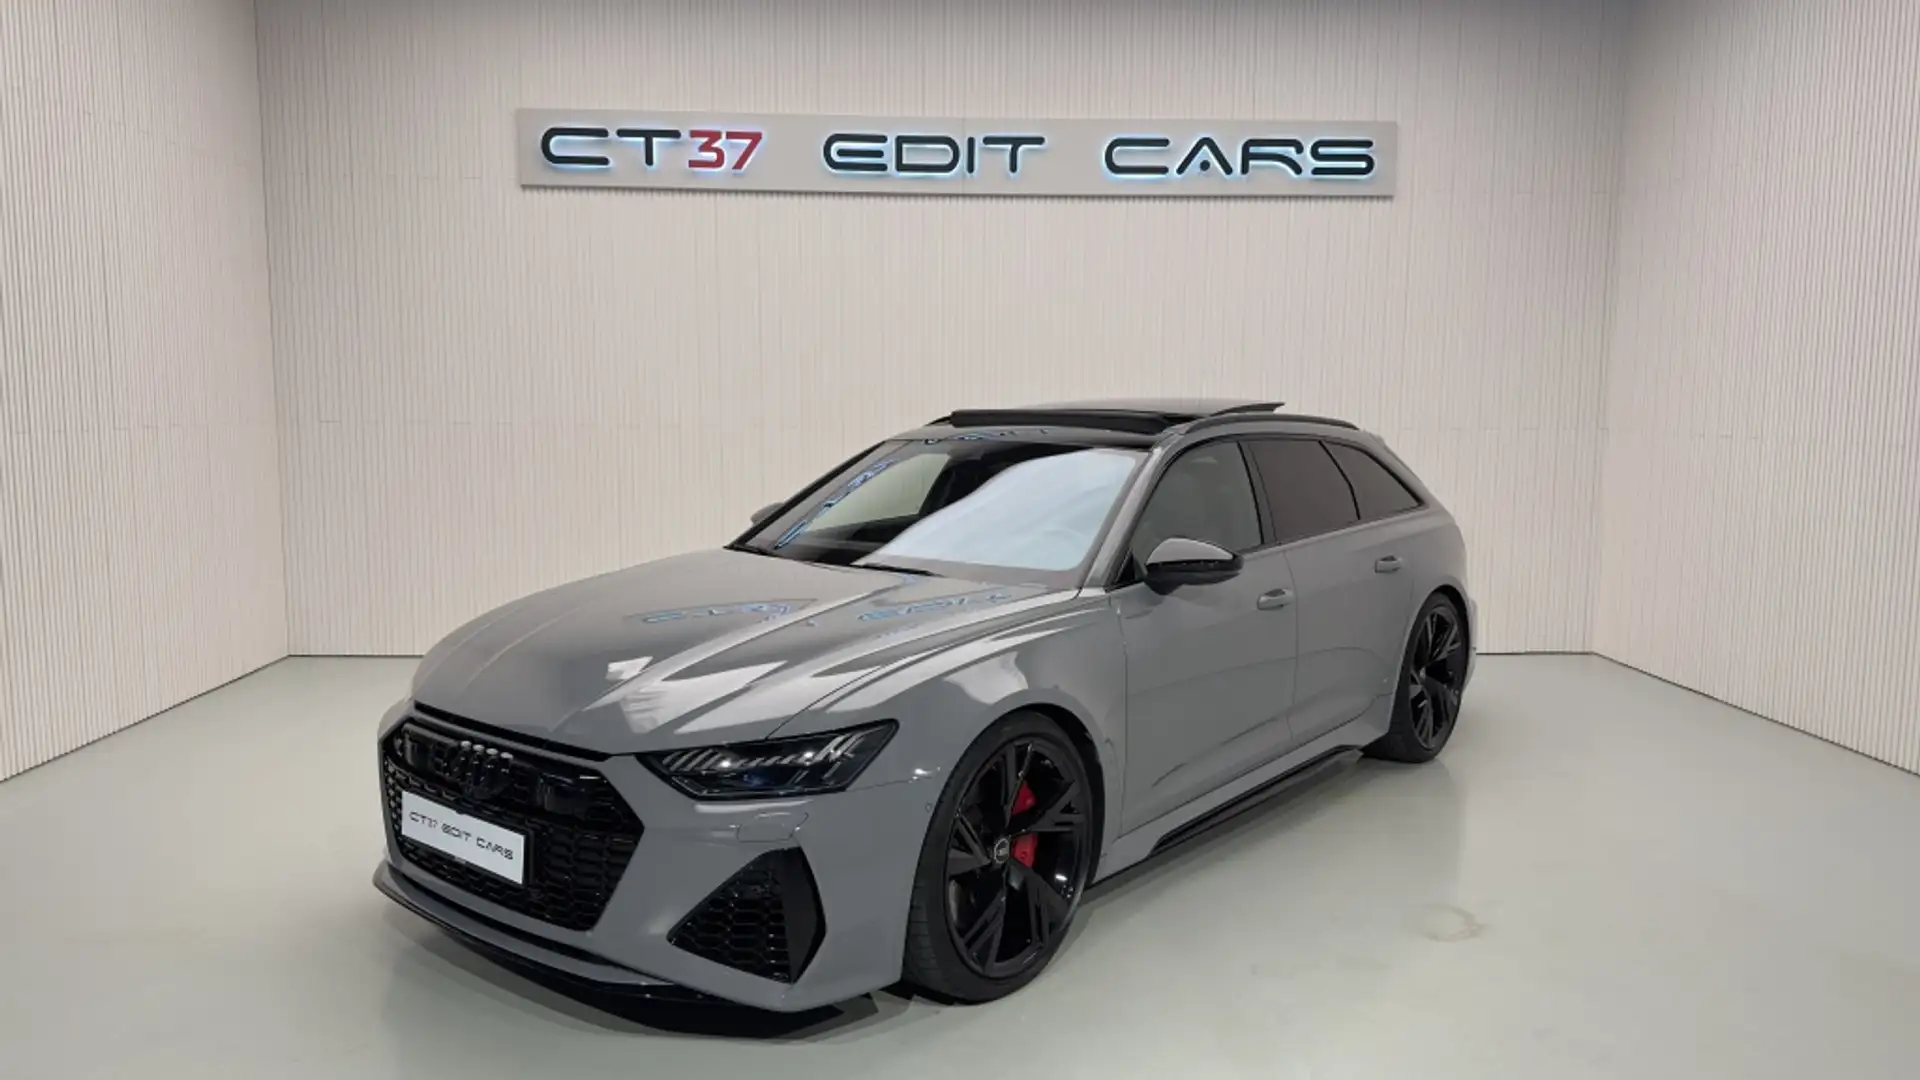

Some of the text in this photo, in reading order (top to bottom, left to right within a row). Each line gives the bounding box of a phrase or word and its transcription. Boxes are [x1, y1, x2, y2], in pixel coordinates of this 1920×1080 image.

[540, 126, 1376, 177] CT37 EDIT CARS
[441, 823, 472, 841] EDIT
[476, 837, 514, 860] CARS
